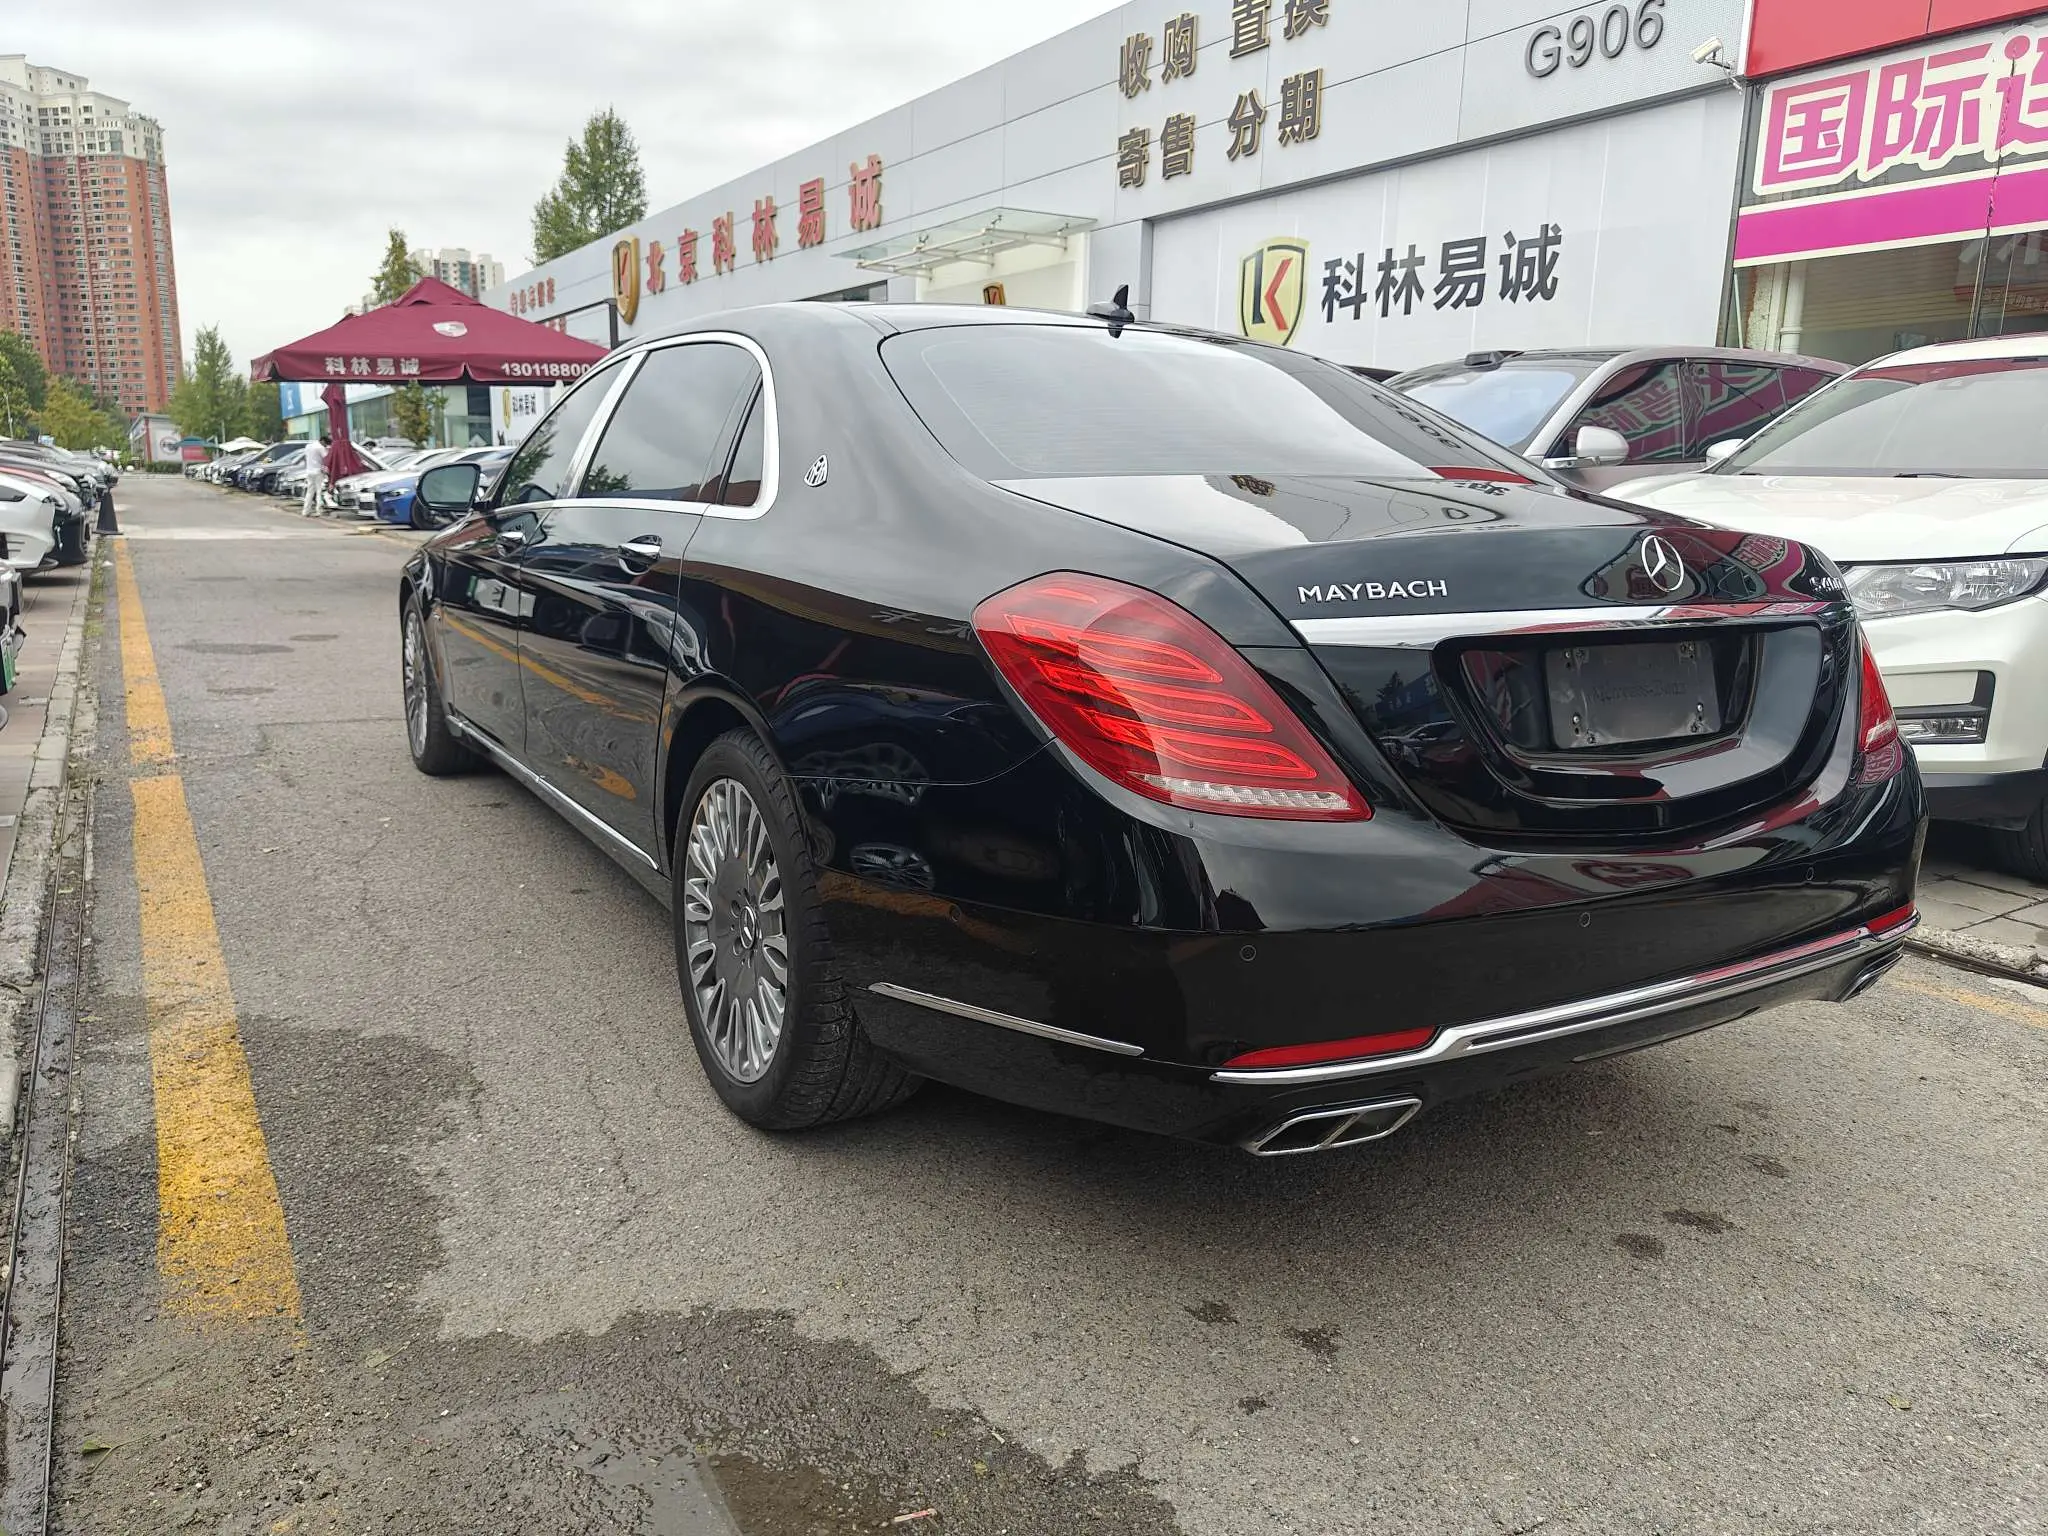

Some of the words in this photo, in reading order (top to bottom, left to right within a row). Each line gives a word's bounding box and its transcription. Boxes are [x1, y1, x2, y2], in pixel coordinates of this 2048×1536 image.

[1119, 13, 1199, 99] 收购
[1525, 0, 1665, 78] G906
[1117, 112, 1196, 188] 寄售
[1226, 67, 1323, 162] 分期
[646, 154, 883, 296] 北京科林易诚
[1321, 223, 1563, 324] 科林易诚
[325, 356, 421, 376] 科林易诚
[1297, 579, 1449, 604] MAYBACH
